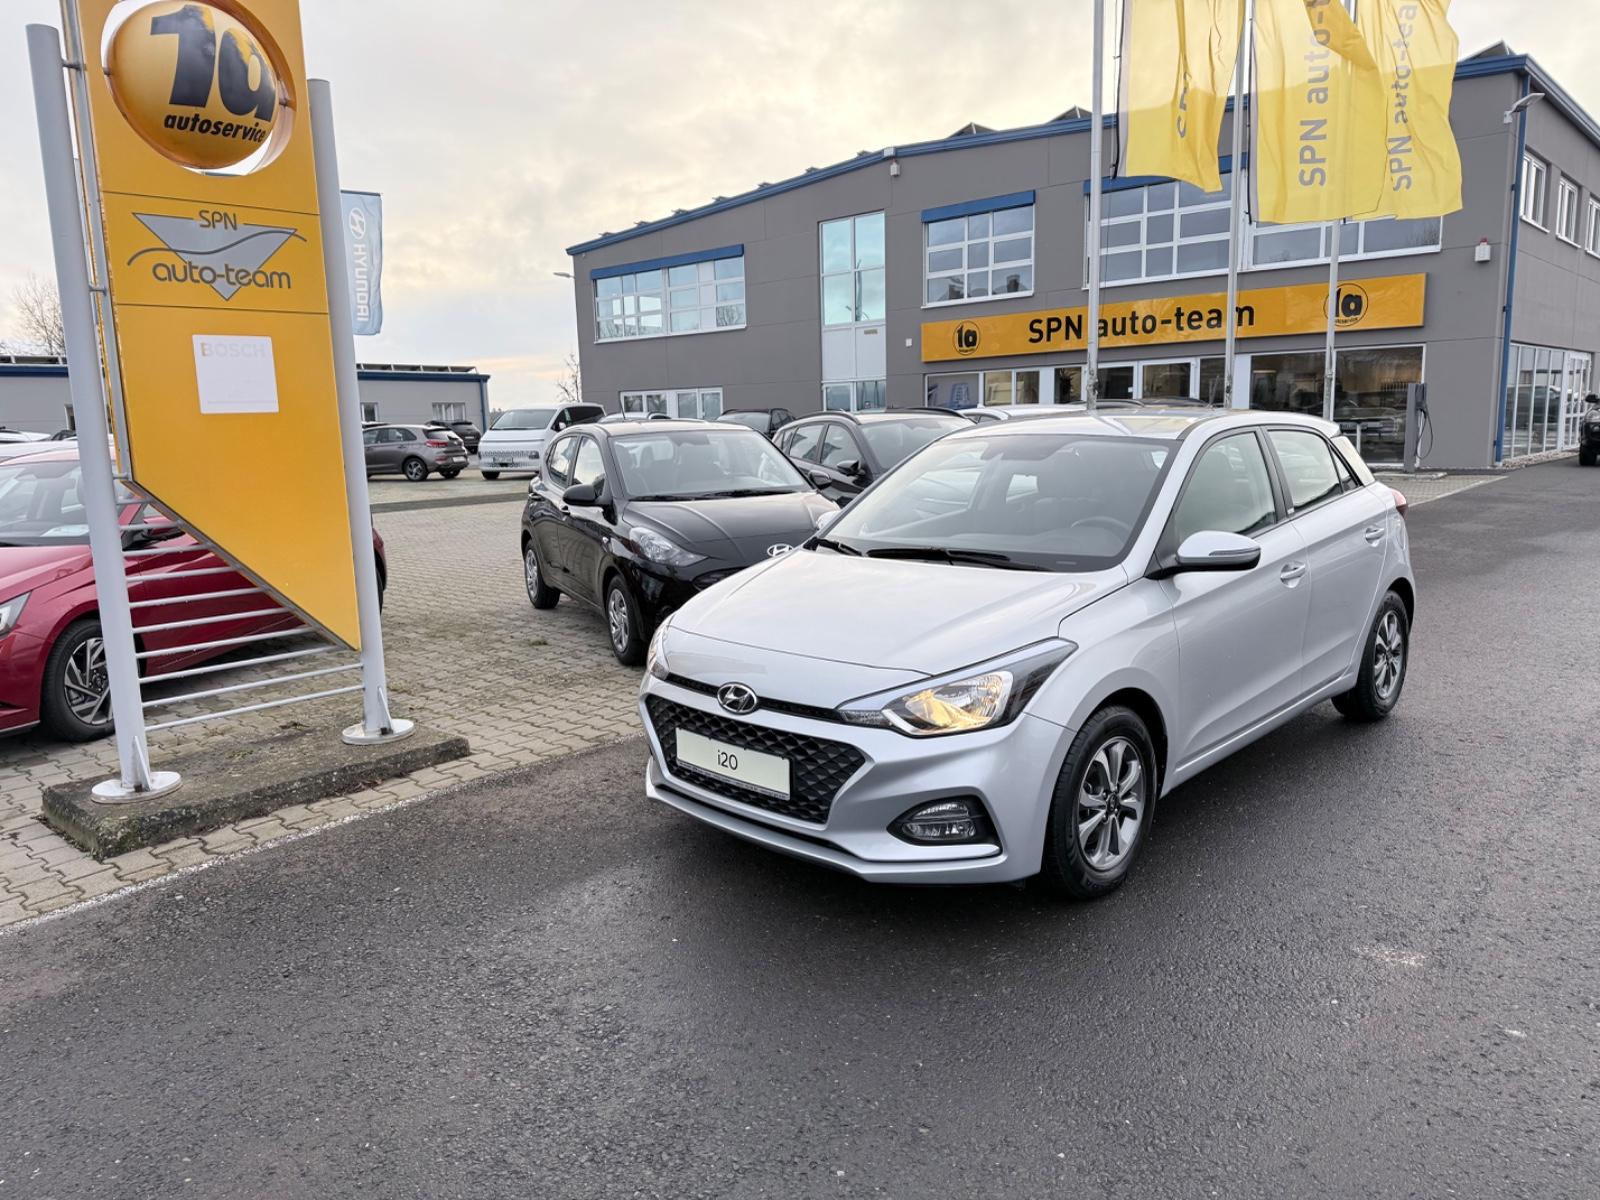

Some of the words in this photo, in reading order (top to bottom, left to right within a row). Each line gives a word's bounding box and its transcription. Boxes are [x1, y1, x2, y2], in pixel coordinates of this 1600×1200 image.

[163, 112, 267, 144] autoservice
[1299, 118, 1328, 187] SPN
[1388, 135, 1413, 192] SPN
[198, 209, 238, 231] SPN
[152, 262, 292, 289] auto-team
[354, 243, 370, 323] HYUNDAI
[1028, 315, 1083, 344] SPN
[1098, 306, 1255, 338] auto-team
[200, 342, 268, 358] BOSCH
[717, 749, 738, 771] i20
